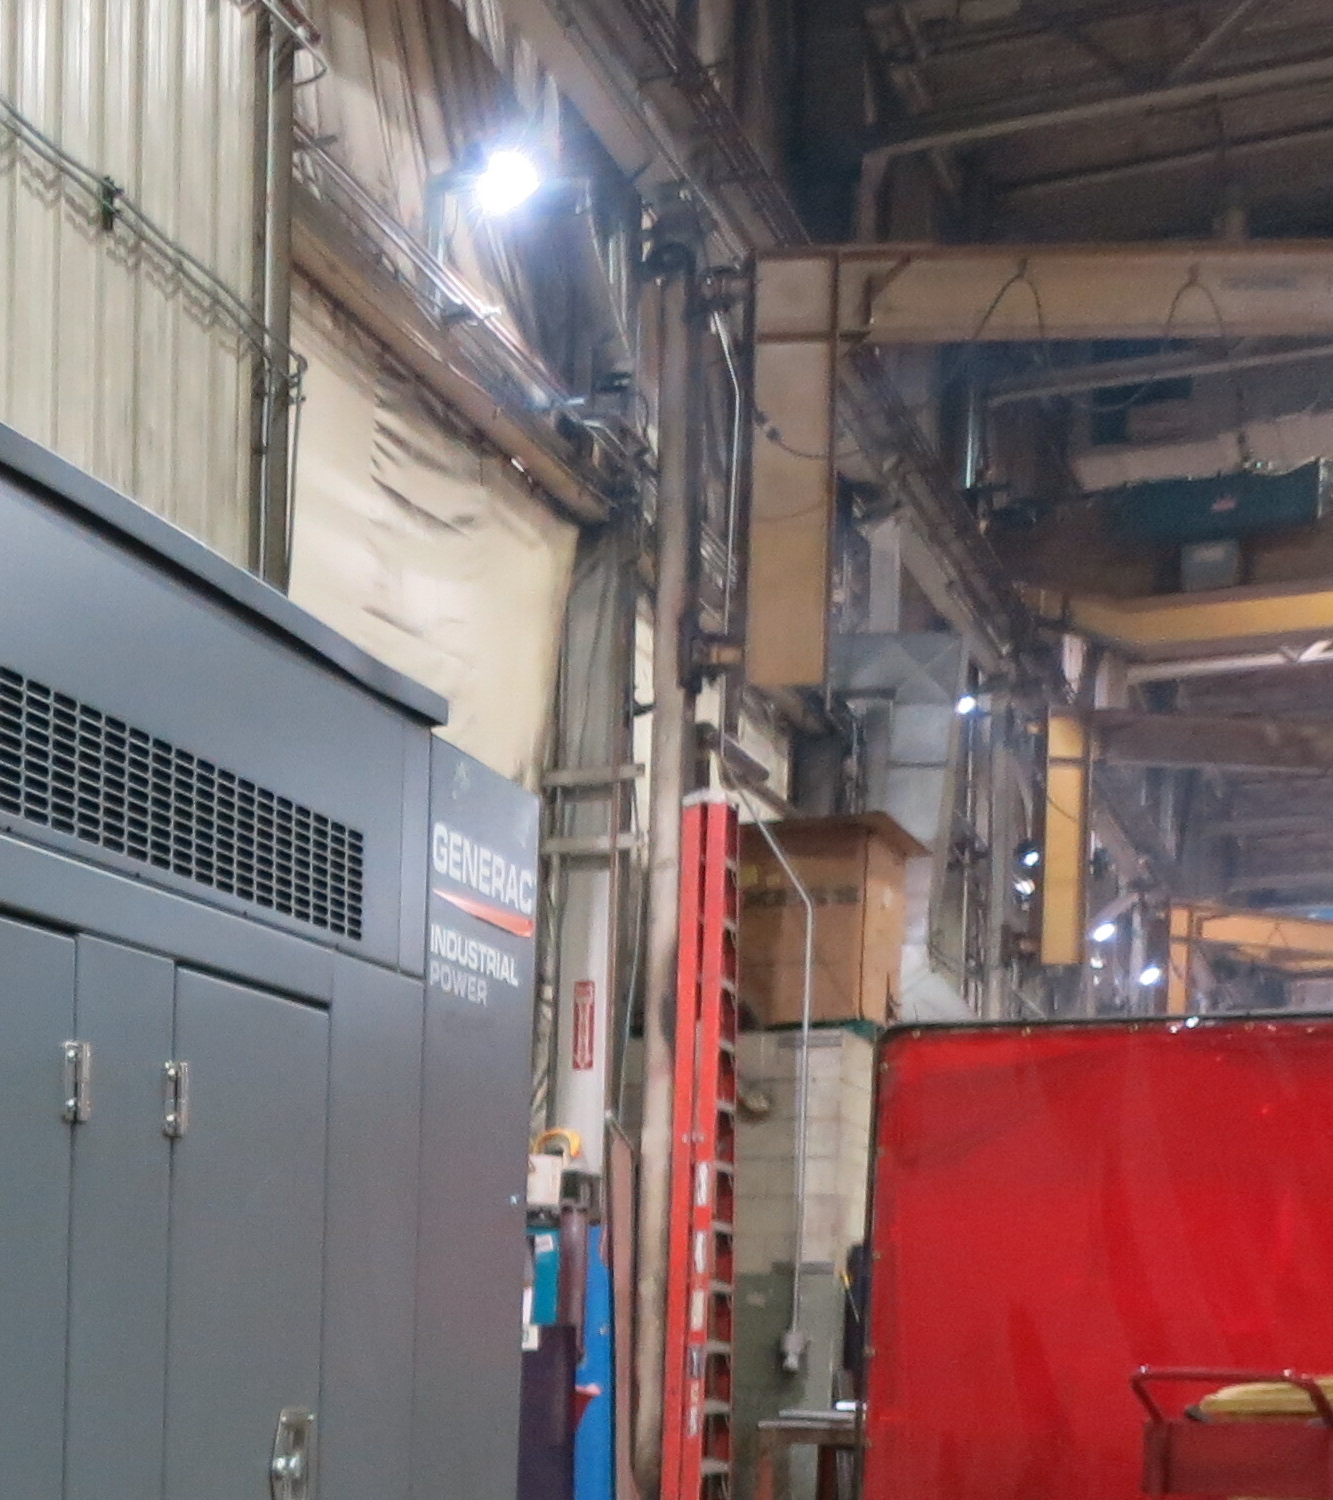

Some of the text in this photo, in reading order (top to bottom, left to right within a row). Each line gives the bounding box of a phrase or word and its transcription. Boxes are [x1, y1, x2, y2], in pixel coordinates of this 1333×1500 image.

[432, 822, 533, 915] GENERAC
[429, 960, 487, 1008] POWER
[430, 923, 519, 987] INDUSTRIAL
